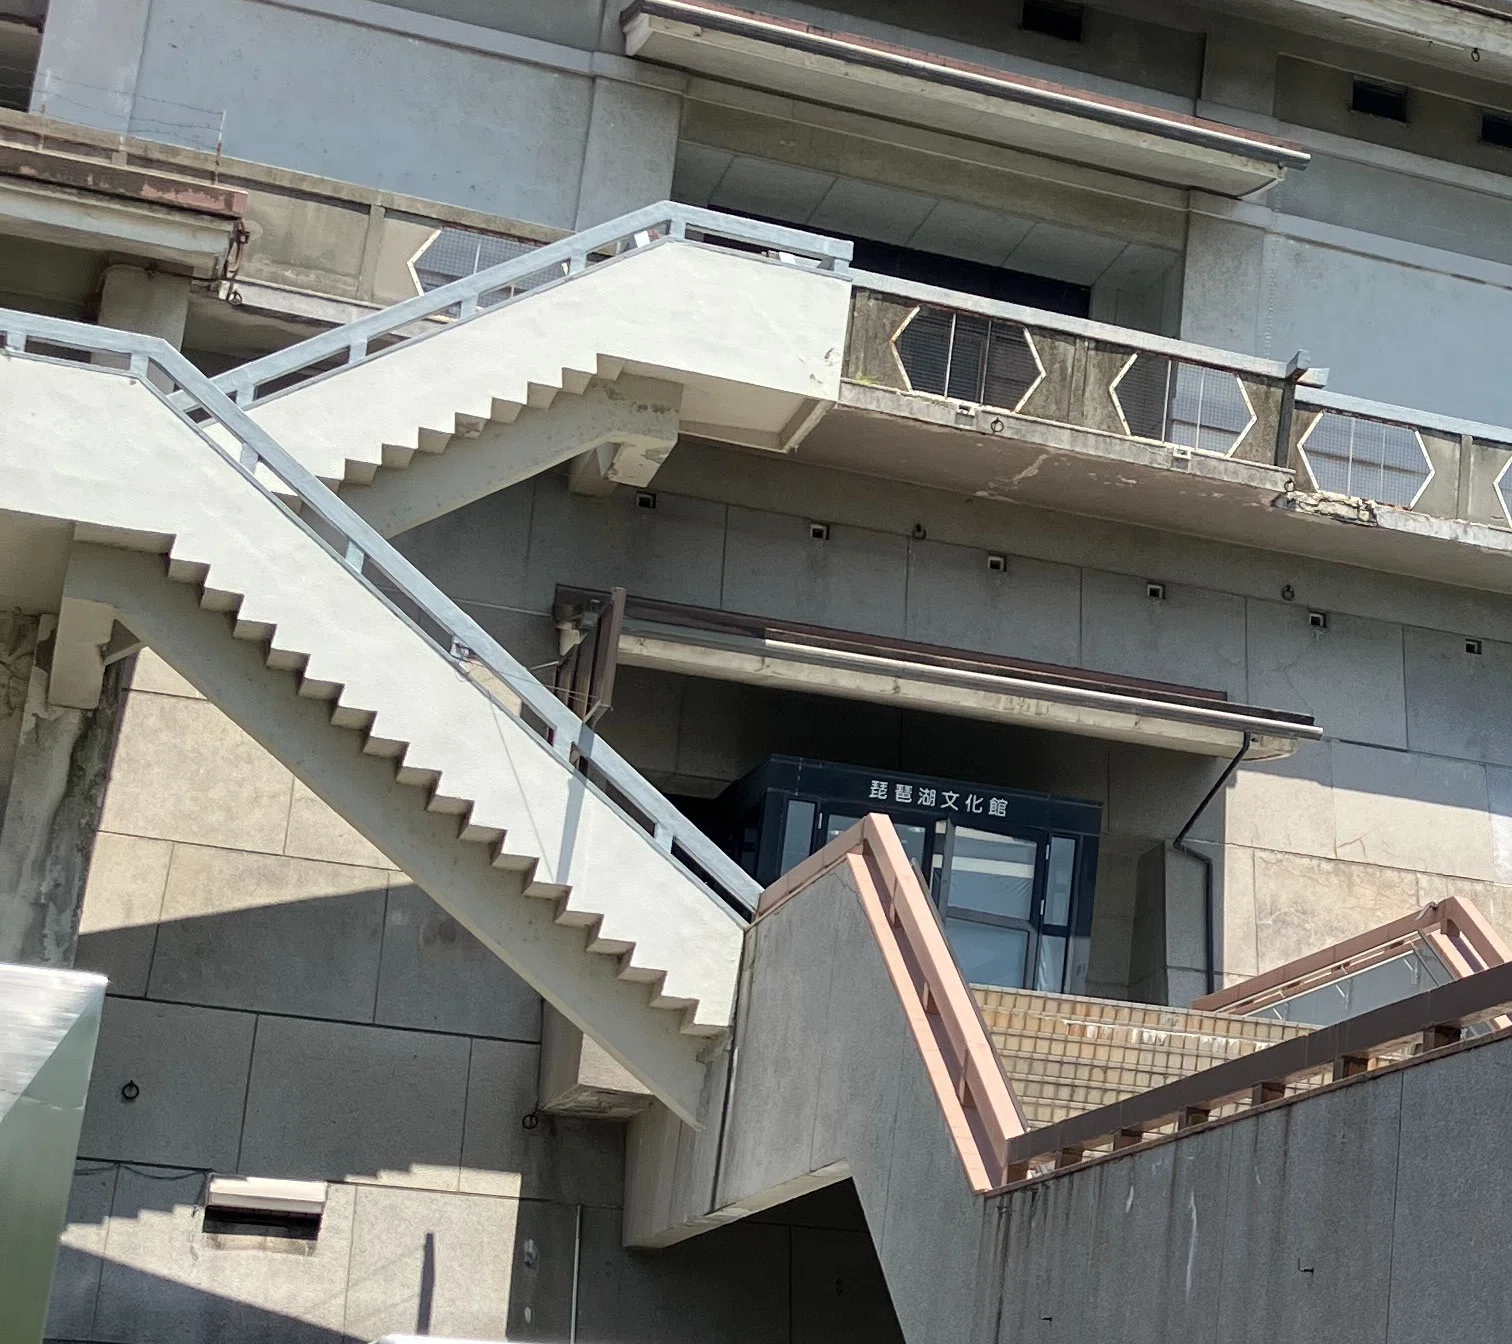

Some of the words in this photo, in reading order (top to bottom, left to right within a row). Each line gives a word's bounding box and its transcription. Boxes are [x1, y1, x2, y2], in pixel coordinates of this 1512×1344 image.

[869, 780, 1008, 817] 琵琶湖文化館
